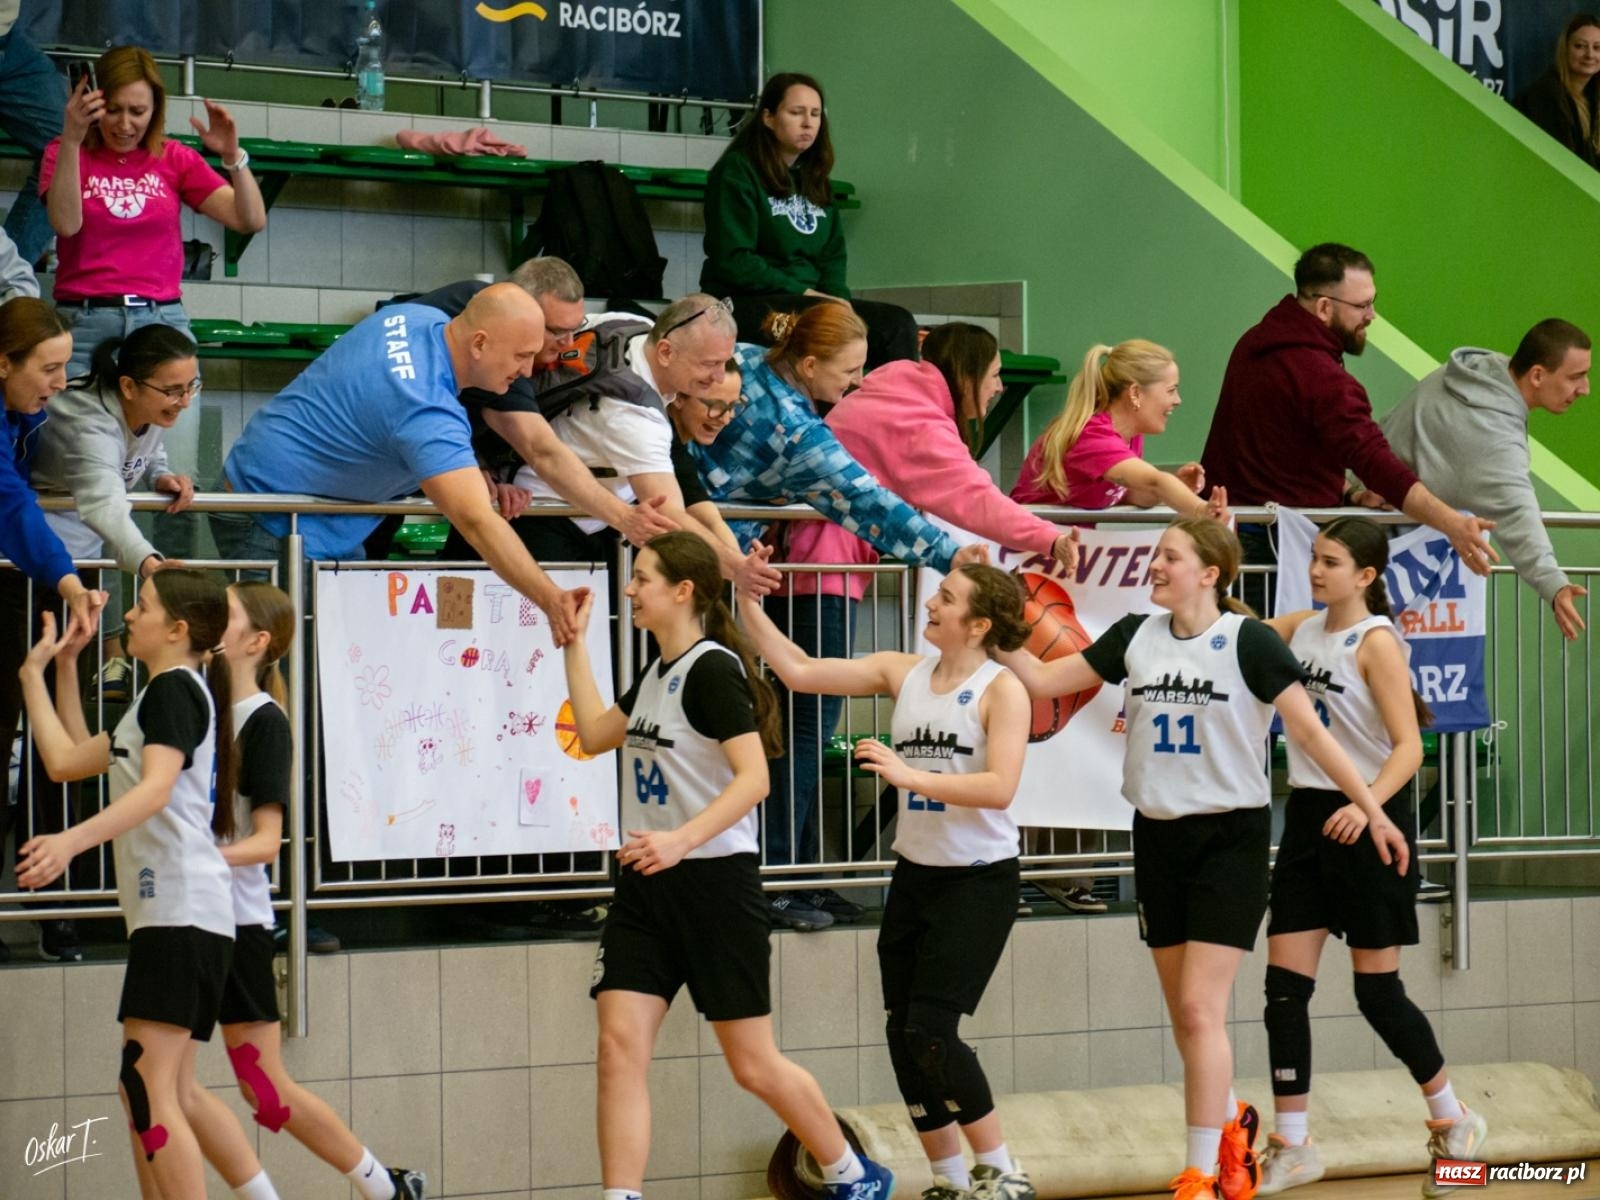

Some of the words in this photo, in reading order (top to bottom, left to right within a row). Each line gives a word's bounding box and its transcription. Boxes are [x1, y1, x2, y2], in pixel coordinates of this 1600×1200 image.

[559, 2, 681, 38] RACIBÓRZ
[384, 315, 416, 380] STAFF
[1143, 689, 1211, 706] WARSAW
[903, 745, 954, 760] WARSAW
[1152, 713, 1201, 754] 11
[634, 757, 669, 805] 64
